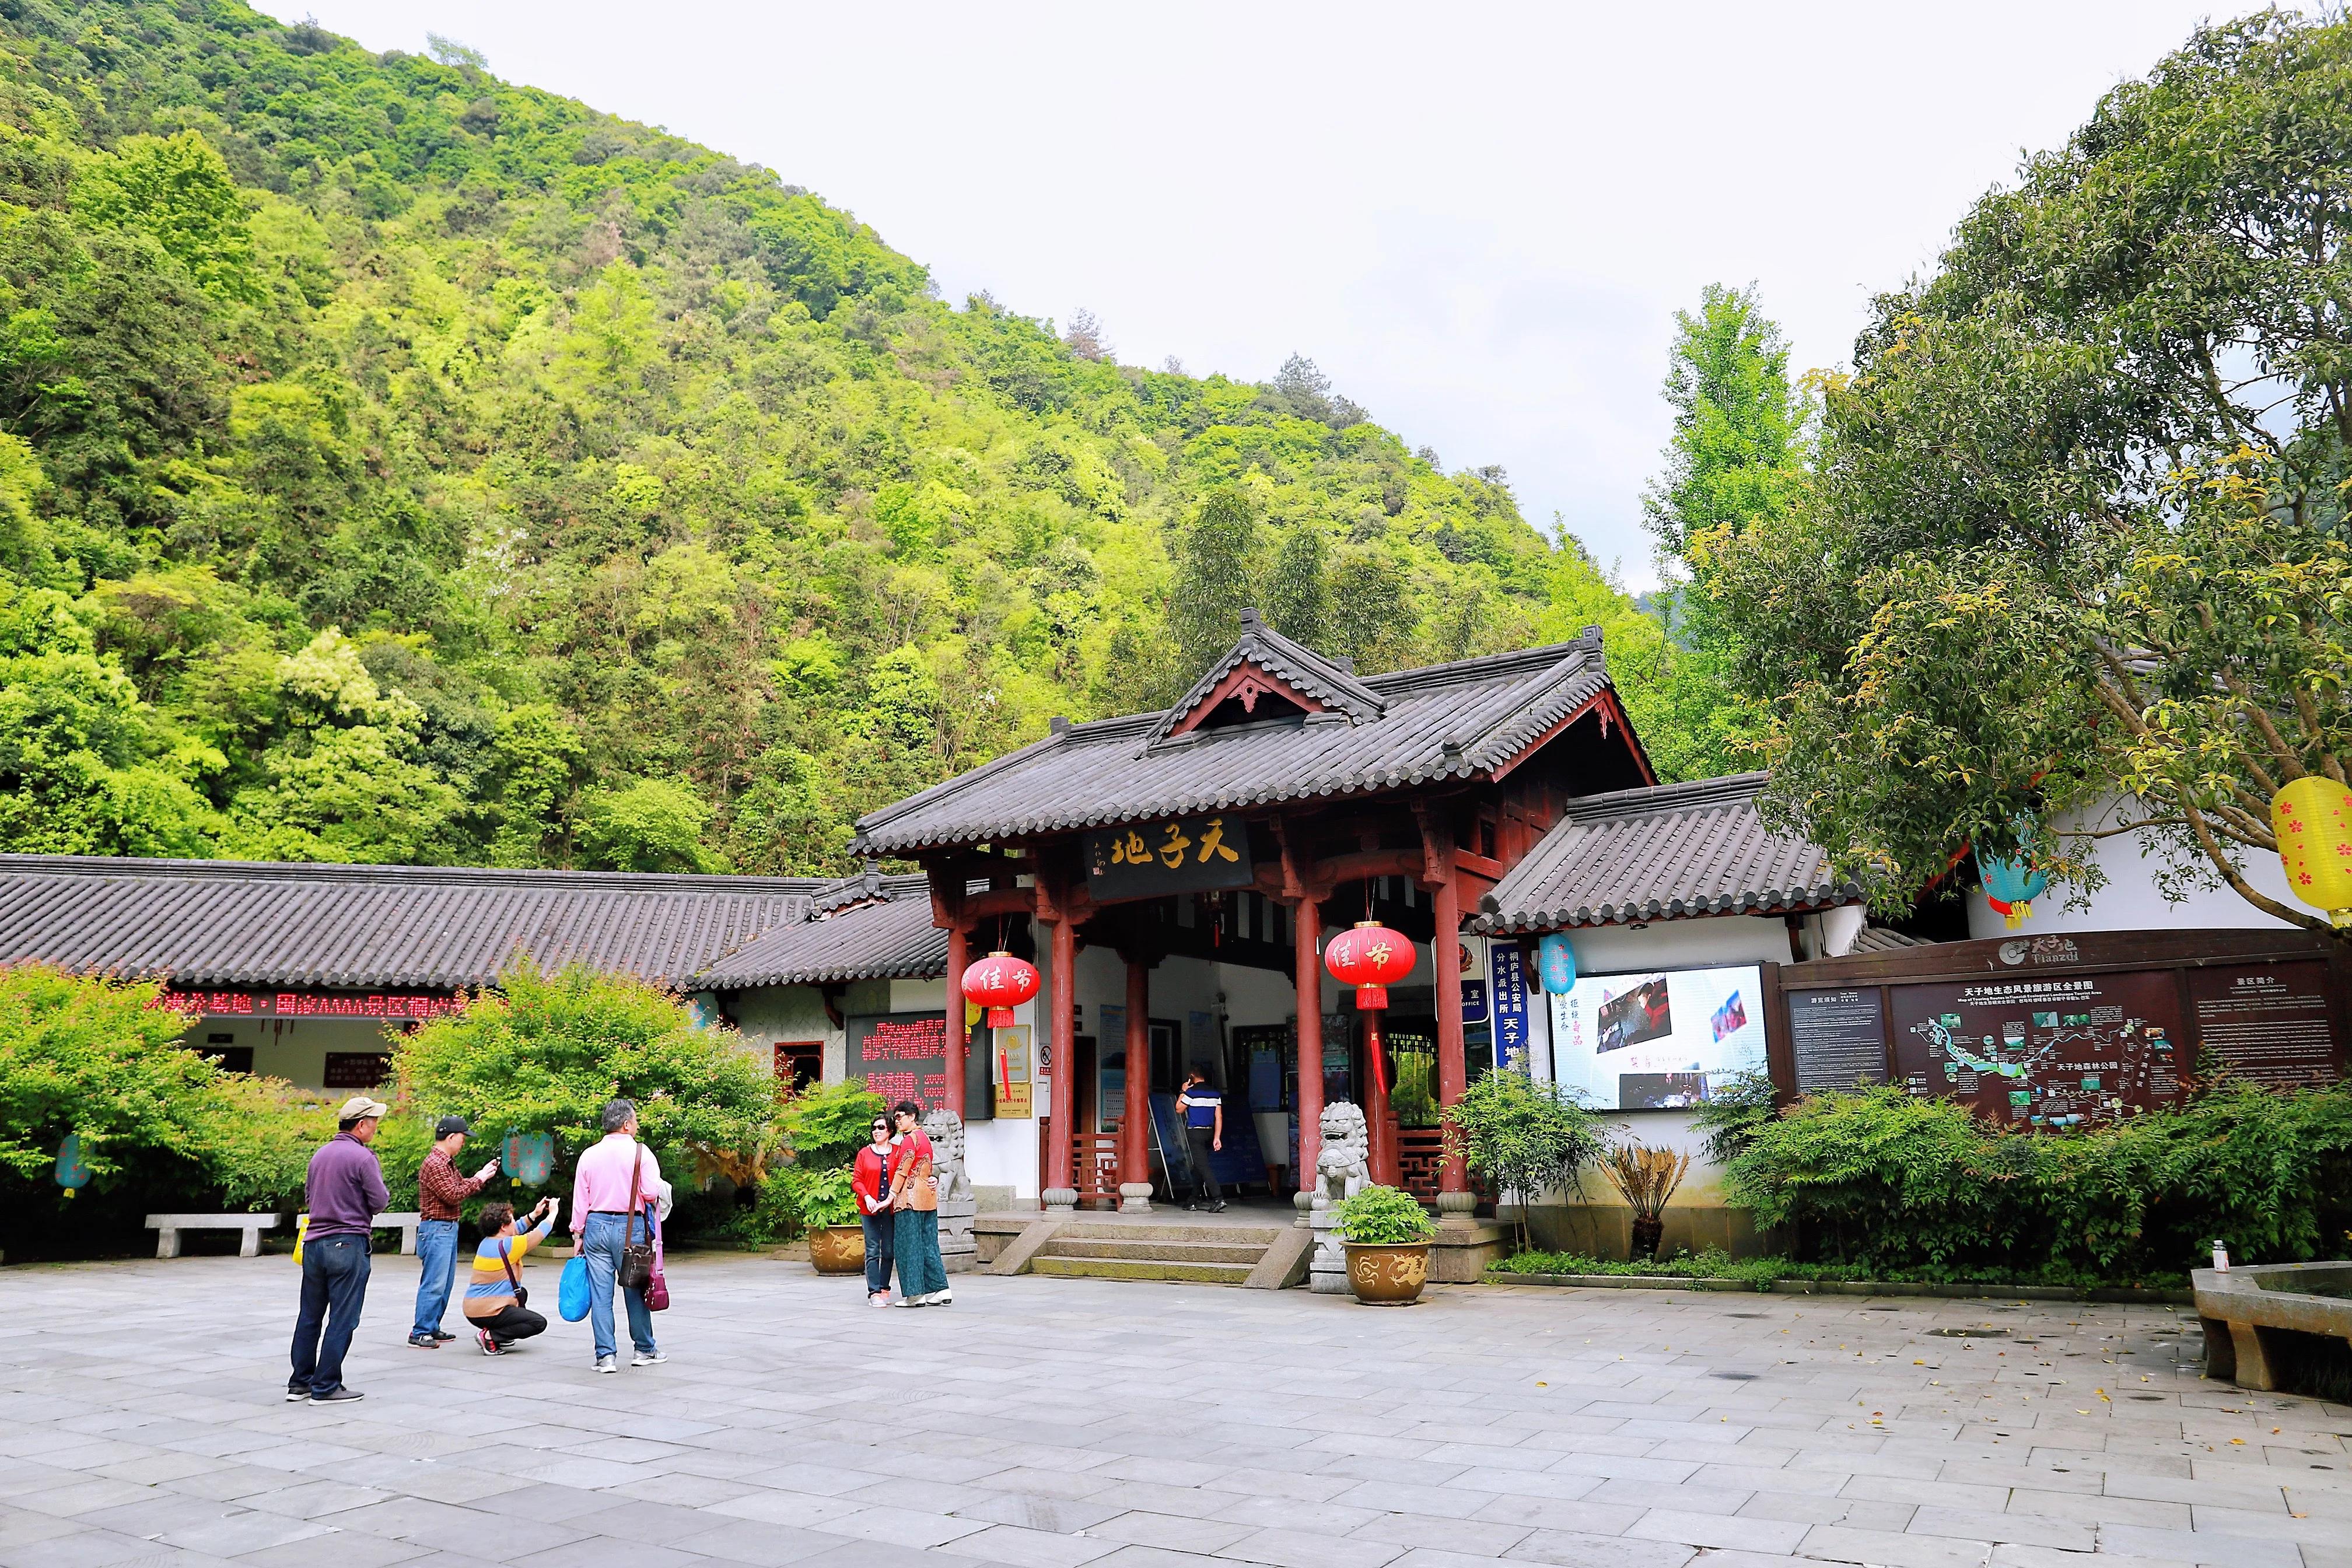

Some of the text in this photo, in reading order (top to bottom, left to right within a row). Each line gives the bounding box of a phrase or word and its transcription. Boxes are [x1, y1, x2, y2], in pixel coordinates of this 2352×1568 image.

[1111, 818, 1239, 869] 天子地
[1332, 939, 1393, 971] 佳节
[2031, 935, 2078, 954] 天子地
[1496, 953, 1508, 1014] 分水派出所
[1509, 951, 1522, 1013] 桐庐县公安局
[1964, 981, 2094, 996] 天子地生态风景旅游区全景图
[2236, 977, 2275, 985] 景区简介
[2057, 1061, 2118, 1071] 天子地森林公园
